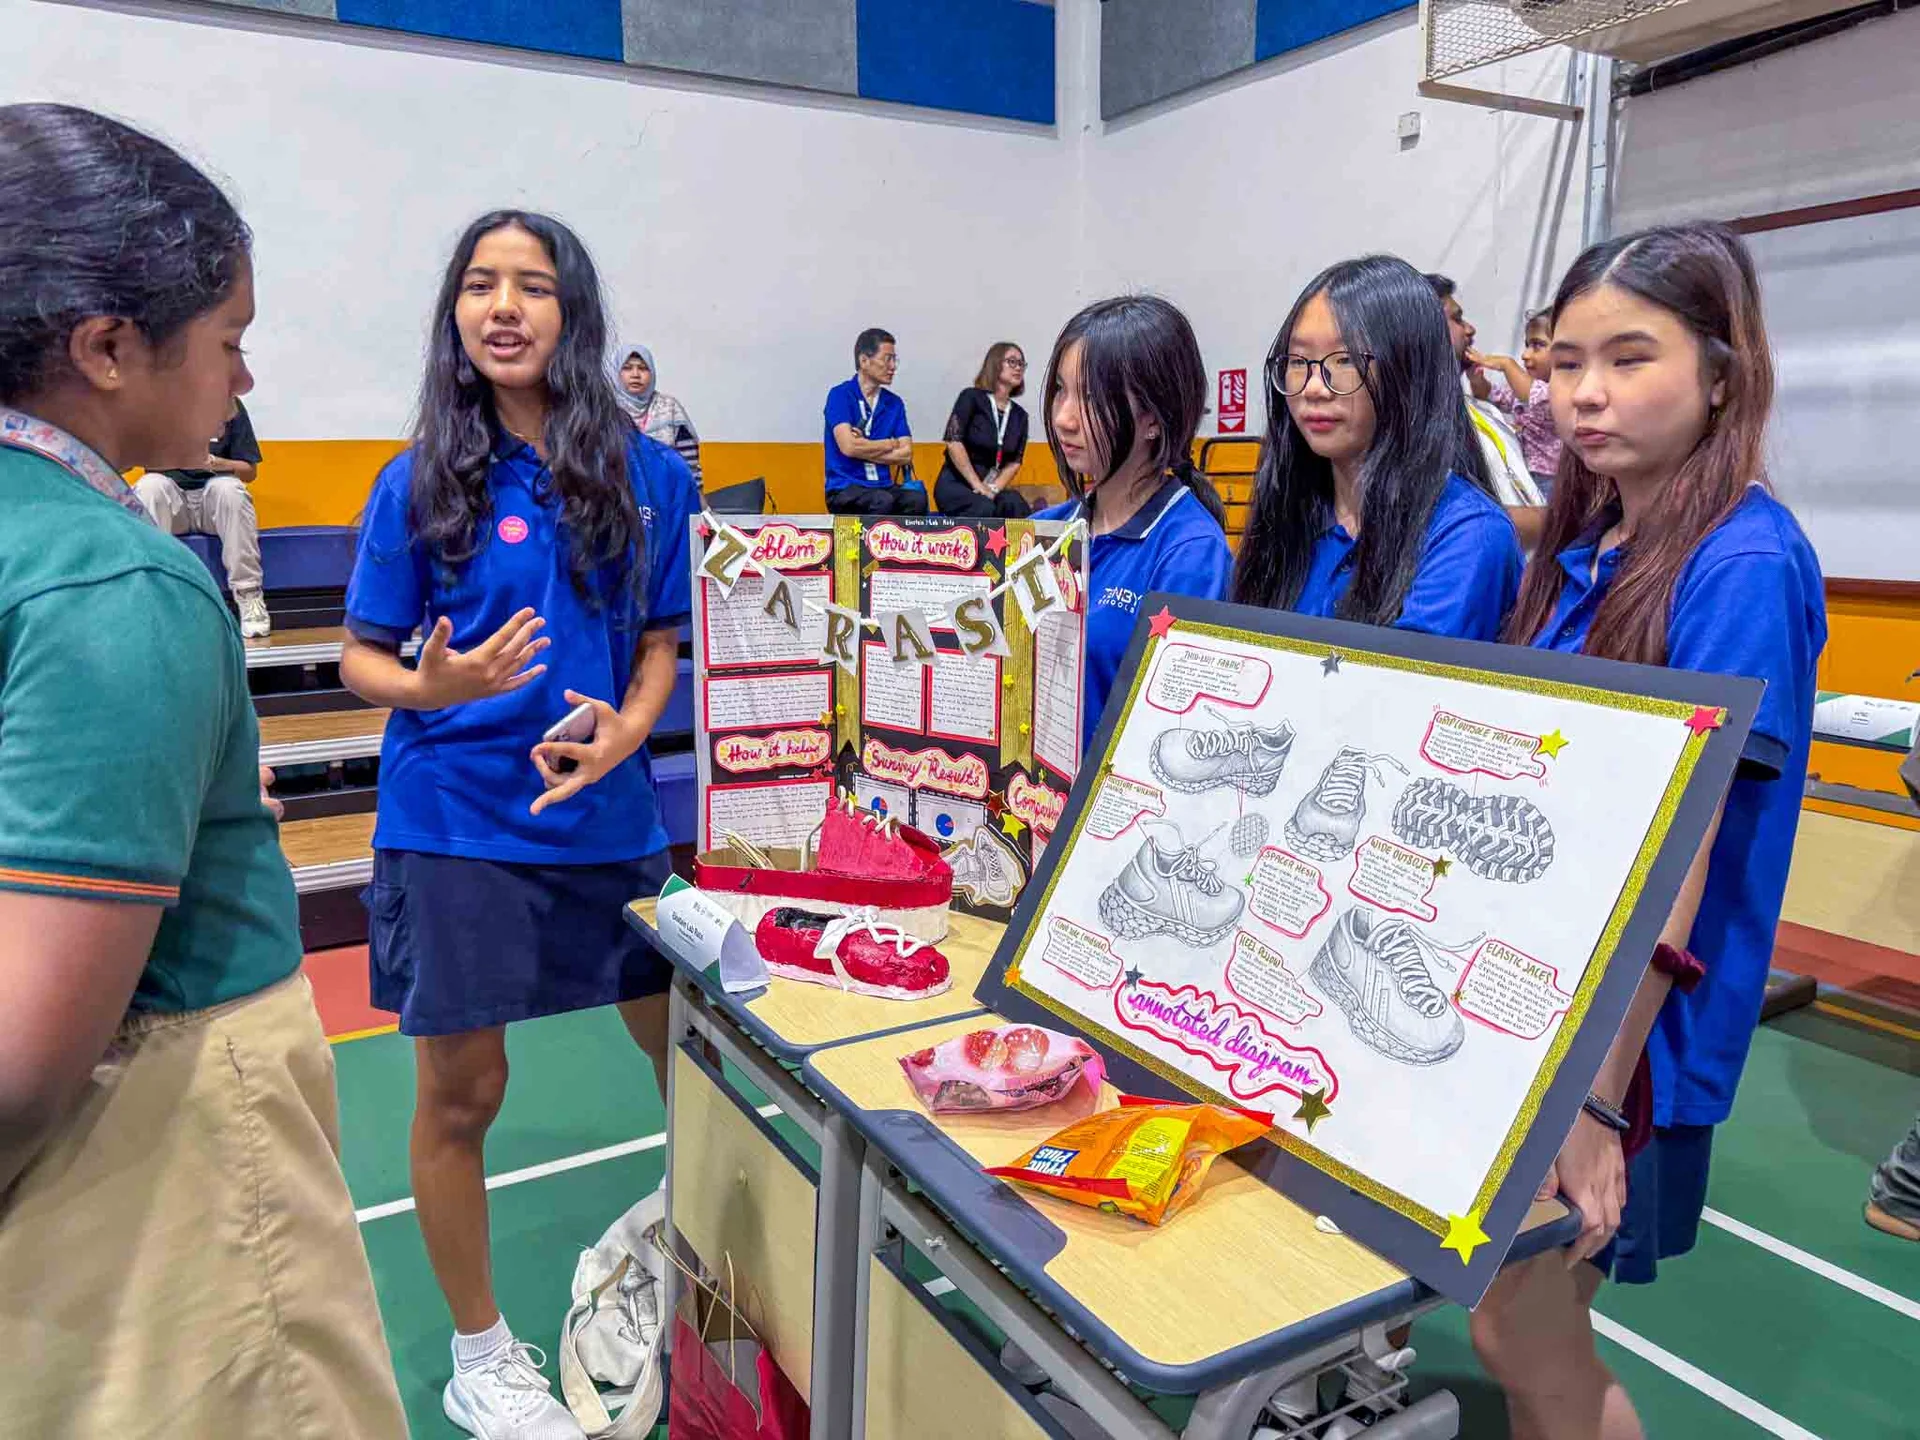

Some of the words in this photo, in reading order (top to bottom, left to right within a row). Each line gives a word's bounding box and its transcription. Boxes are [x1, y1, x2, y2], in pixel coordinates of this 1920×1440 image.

[750, 533, 816, 561] oblem
[879, 532, 909, 552] How
[912, 534, 924, 555] it
[928, 538, 970, 560] works
[728, 743, 762, 763] How
[768, 741, 781, 758] it
[926, 753, 980, 788] Results
[1265, 850, 1295, 869] SPACER
[1370, 838, 1393, 855] WIDE
[1486, 942, 1523, 968] ELASTIC
[1127, 992, 1230, 1048] annotated
[1223, 1025, 1319, 1085] diagram
